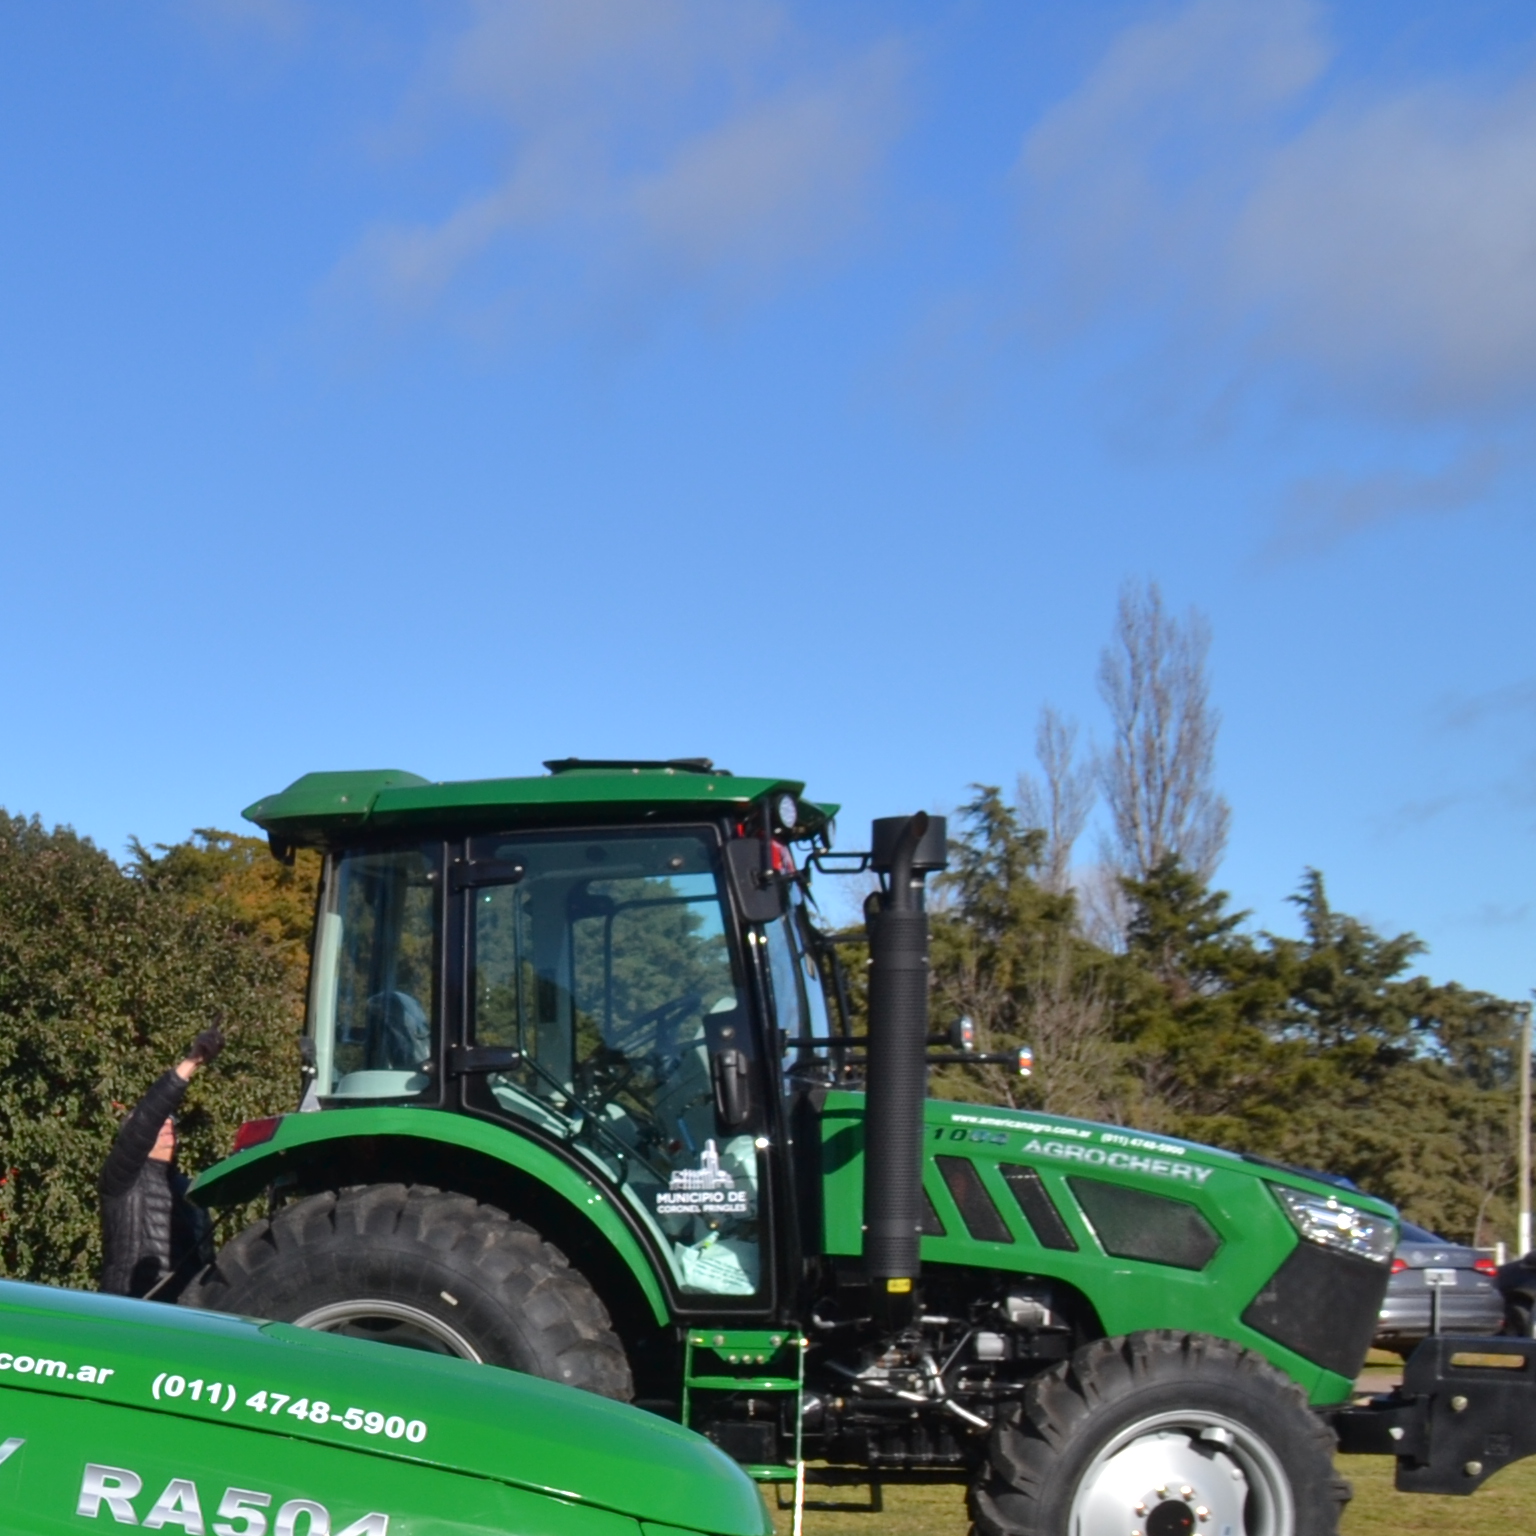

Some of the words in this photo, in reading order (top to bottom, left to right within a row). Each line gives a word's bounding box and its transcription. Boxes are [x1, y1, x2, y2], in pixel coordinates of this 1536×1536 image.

[1021, 1137, 1215, 1184] AGROCHERY
[656, 1191, 725, 1204] MUNICIPIO
[728, 1191, 747, 1204] DE
[151, 1371, 235, 1413] (011)
[244, 1389, 428, 1444] 4748-5900
